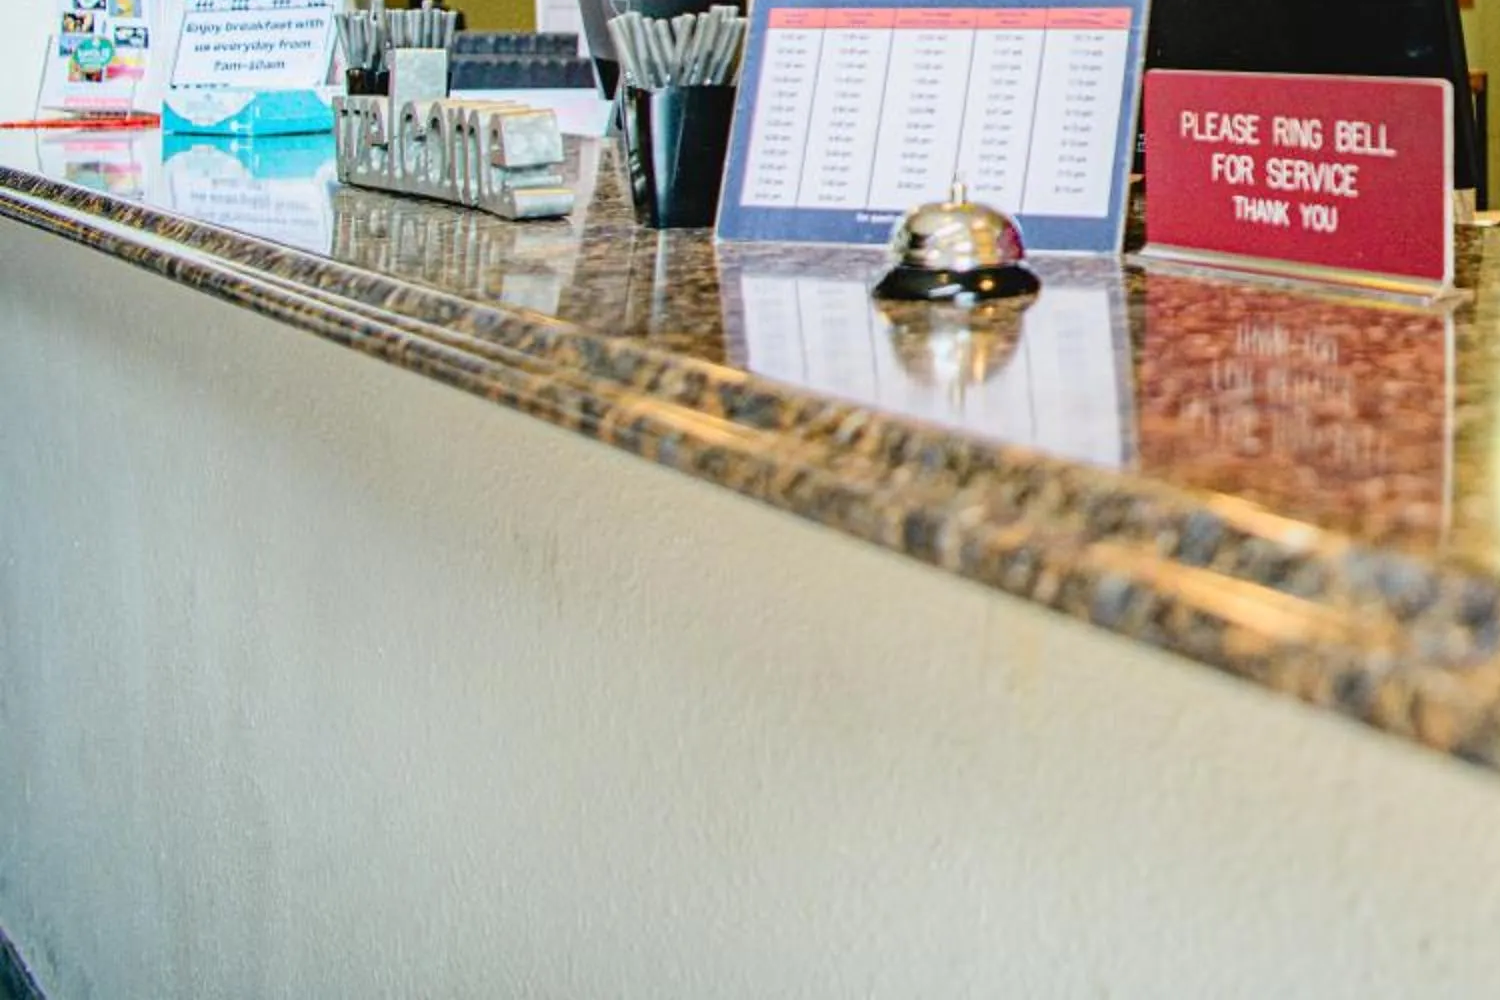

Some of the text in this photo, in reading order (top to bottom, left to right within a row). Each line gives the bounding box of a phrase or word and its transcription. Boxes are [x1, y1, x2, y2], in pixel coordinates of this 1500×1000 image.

[186, 18, 324, 34] Enjoy breakfast with
[194, 39, 311, 52] us everyday from
[214, 60, 285, 71] 7am-10am
[1180, 111, 1261, 145] PLEASE
[1272, 115, 1323, 150] RING
[1335, 120, 1397, 157] BELL
[1211, 153, 1359, 197] FOR SERVICE
[1232, 195, 1338, 232] THANK YOU
